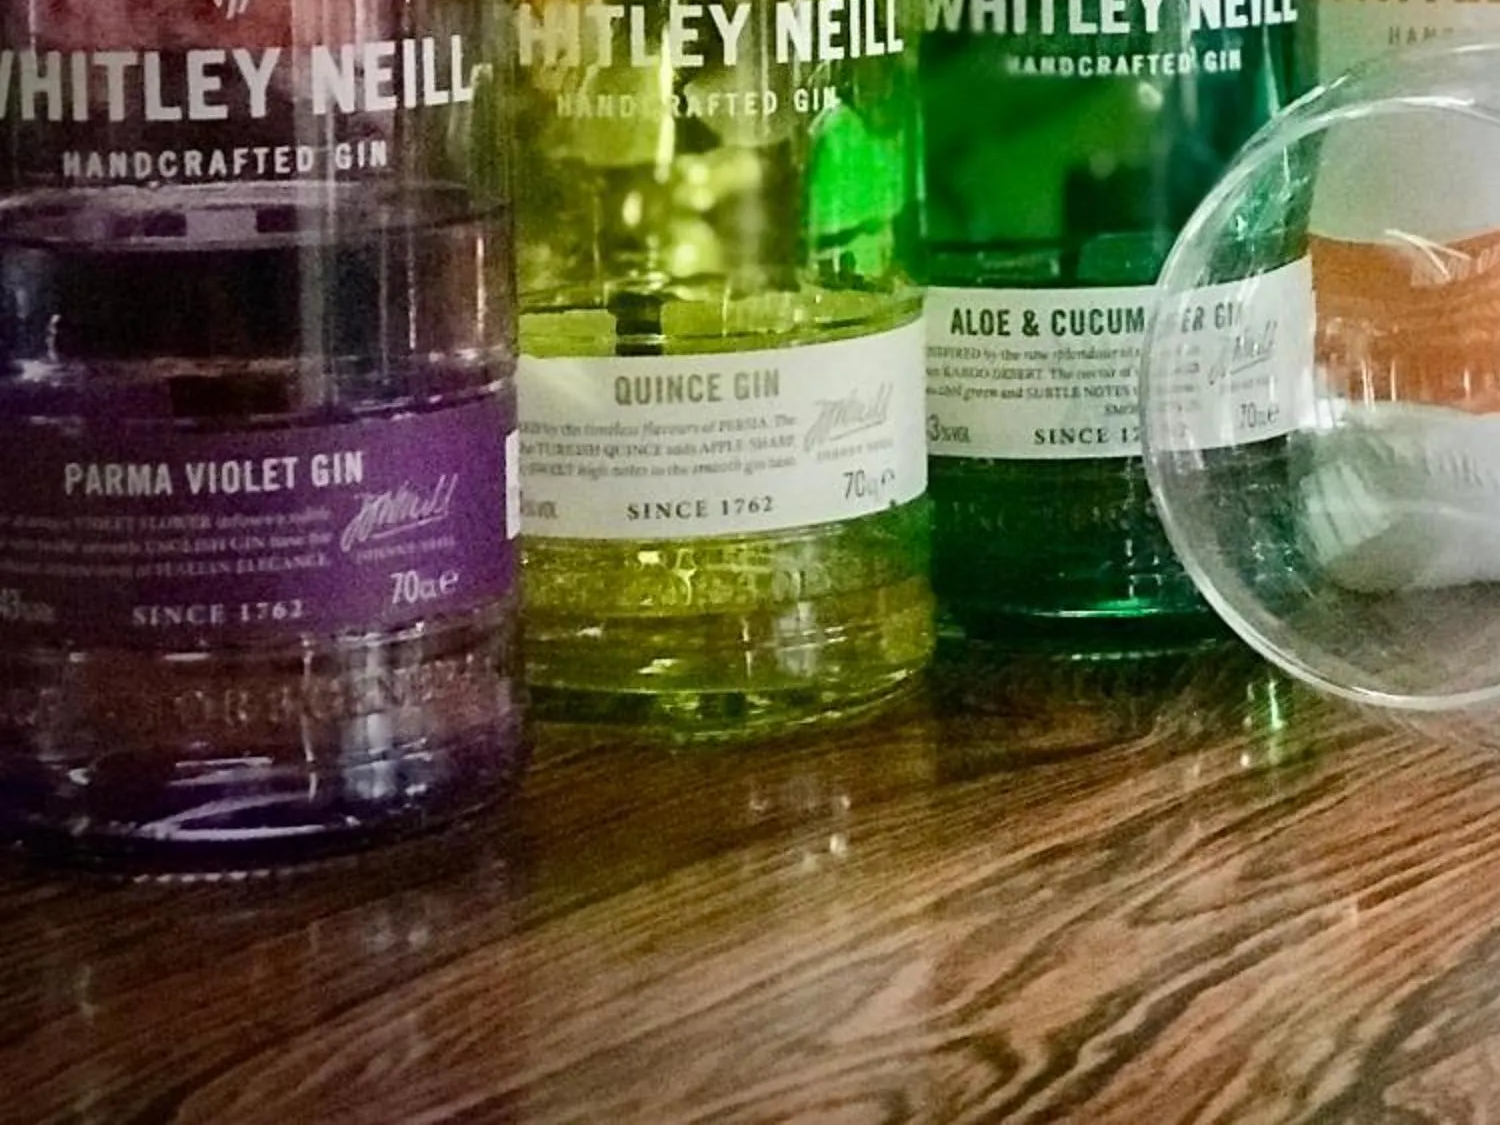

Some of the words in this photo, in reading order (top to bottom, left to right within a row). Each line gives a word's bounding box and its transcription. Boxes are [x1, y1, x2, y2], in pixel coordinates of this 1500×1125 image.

[518, 1, 752, 68] HITLEY
[312, 34, 473, 115] NEILL
[1007, 52, 1192, 77] HANDCRAFTED
[1204, 48, 1242, 72] GIN
[557, 90, 777, 118] HANDRAFTED
[793, 87, 839, 113] GIN
[63, 146, 315, 180] HANDCRAFTED
[335, 140, 388, 169] GIN
[950, 307, 1011, 337] ALOE
[1022, 308, 1039, 337] &
[1051, 305, 1205, 337] CUCUMER
[614, 373, 722, 406] QUINCE
[734, 368, 781, 399] GIN
[1034, 426, 1108, 445] SINCE
[64, 462, 174, 496] PARMA
[186, 456, 298, 494] VIOLET
[311, 450, 364, 486] GIN
[627, 499, 708, 521] SINCE
[722, 494, 773, 516] 1762
[132, 603, 224, 626] SINCE
[241, 598, 302, 622] 1762
